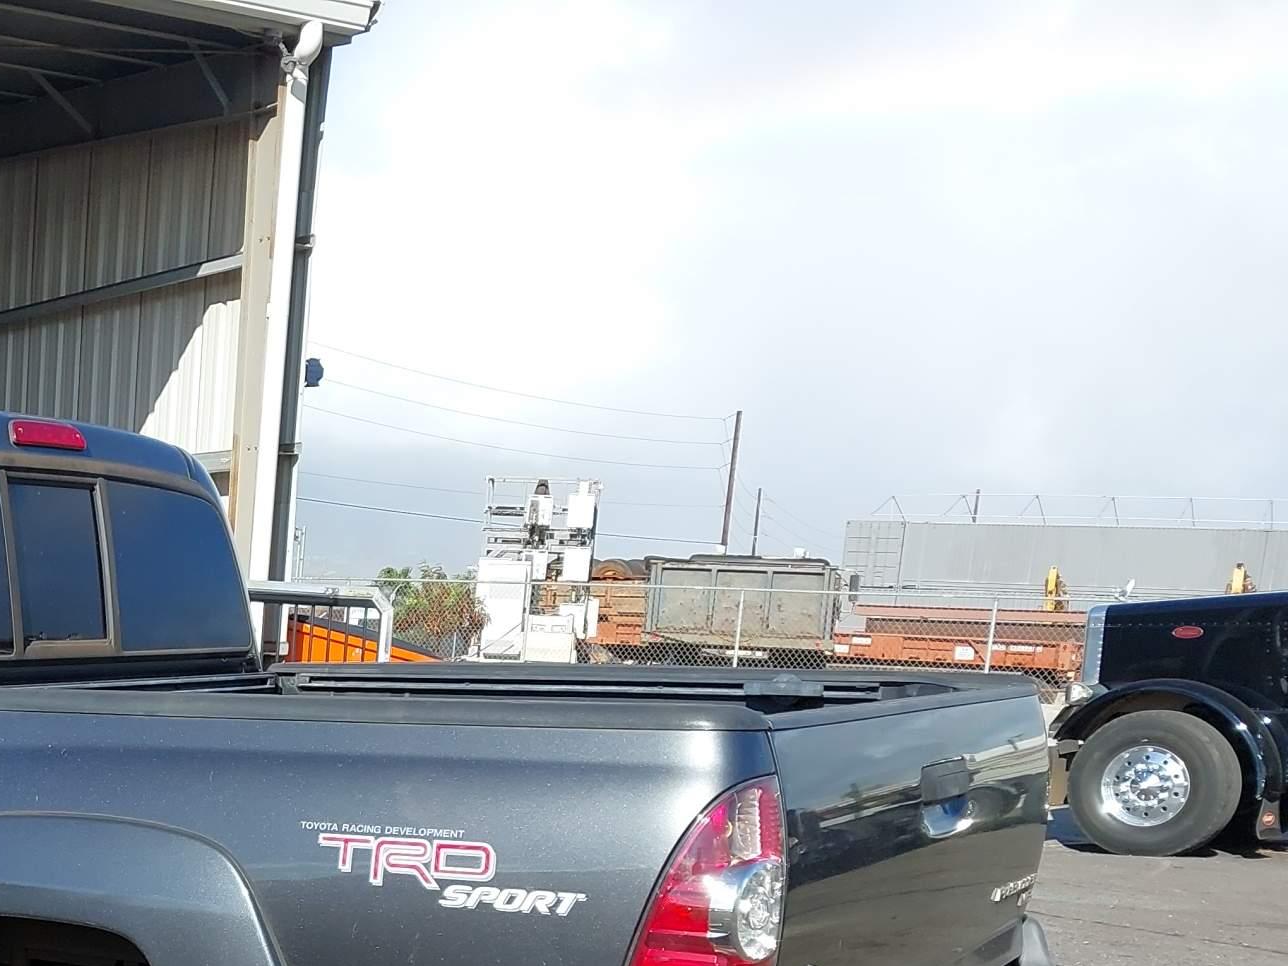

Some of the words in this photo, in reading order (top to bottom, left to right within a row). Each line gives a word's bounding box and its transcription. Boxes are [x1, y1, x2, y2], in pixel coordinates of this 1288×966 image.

[300, 821, 338, 832] TOYOTA
[341, 823, 382, 834] RACING
[384, 825, 465, 839] DEVELOPMENT
[318, 832, 497, 890] TRD
[438, 884, 589, 916] SPORT
